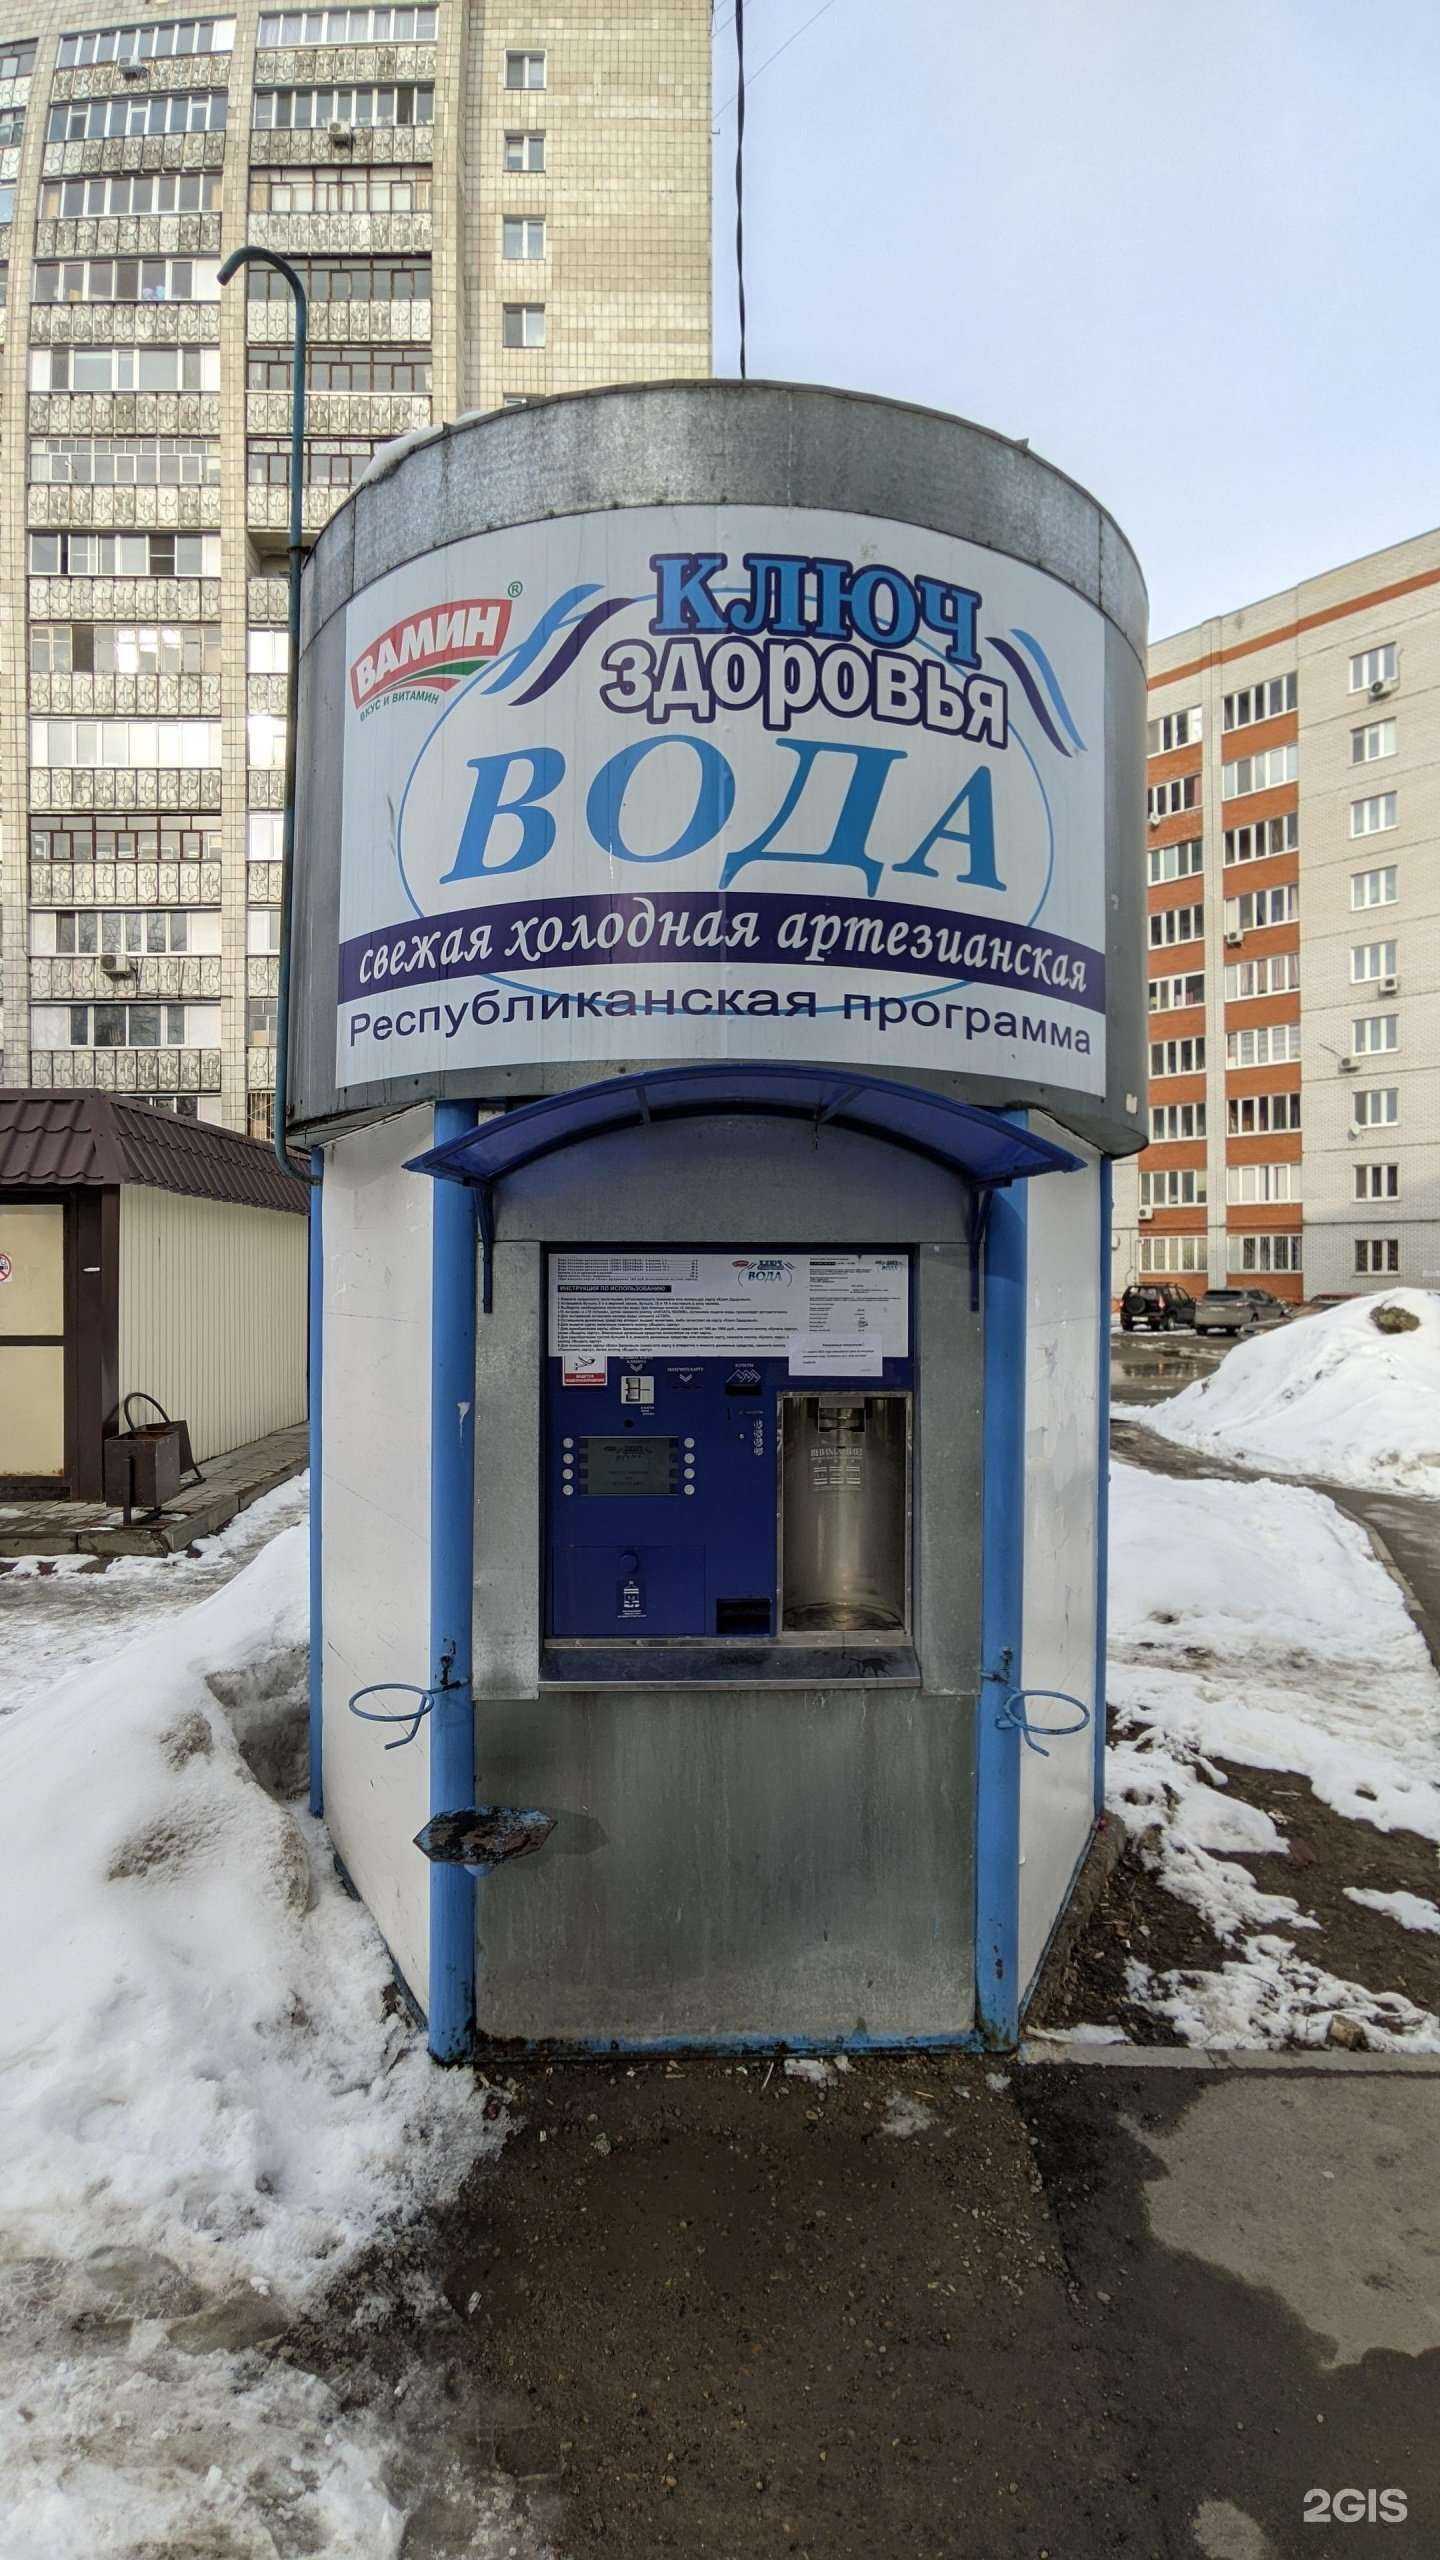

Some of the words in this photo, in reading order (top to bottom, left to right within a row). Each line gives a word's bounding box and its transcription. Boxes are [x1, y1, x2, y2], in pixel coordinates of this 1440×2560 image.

[356, 606, 501, 698] ВАМИН
[649, 553, 982, 669] КЛЮЧ
[359, 700, 382, 722] ВКУС
[391, 690, 440, 705] ВИТАМИН
[439, 734, 1008, 897] ВОДА
[358, 924, 493, 985] свежая
[504, 897, 762, 962] холодная
[777, 909, 1088, 993] артезианская
[350, 987, 817, 1047] Республиканская
[843, 992, 1091, 1056] программа
